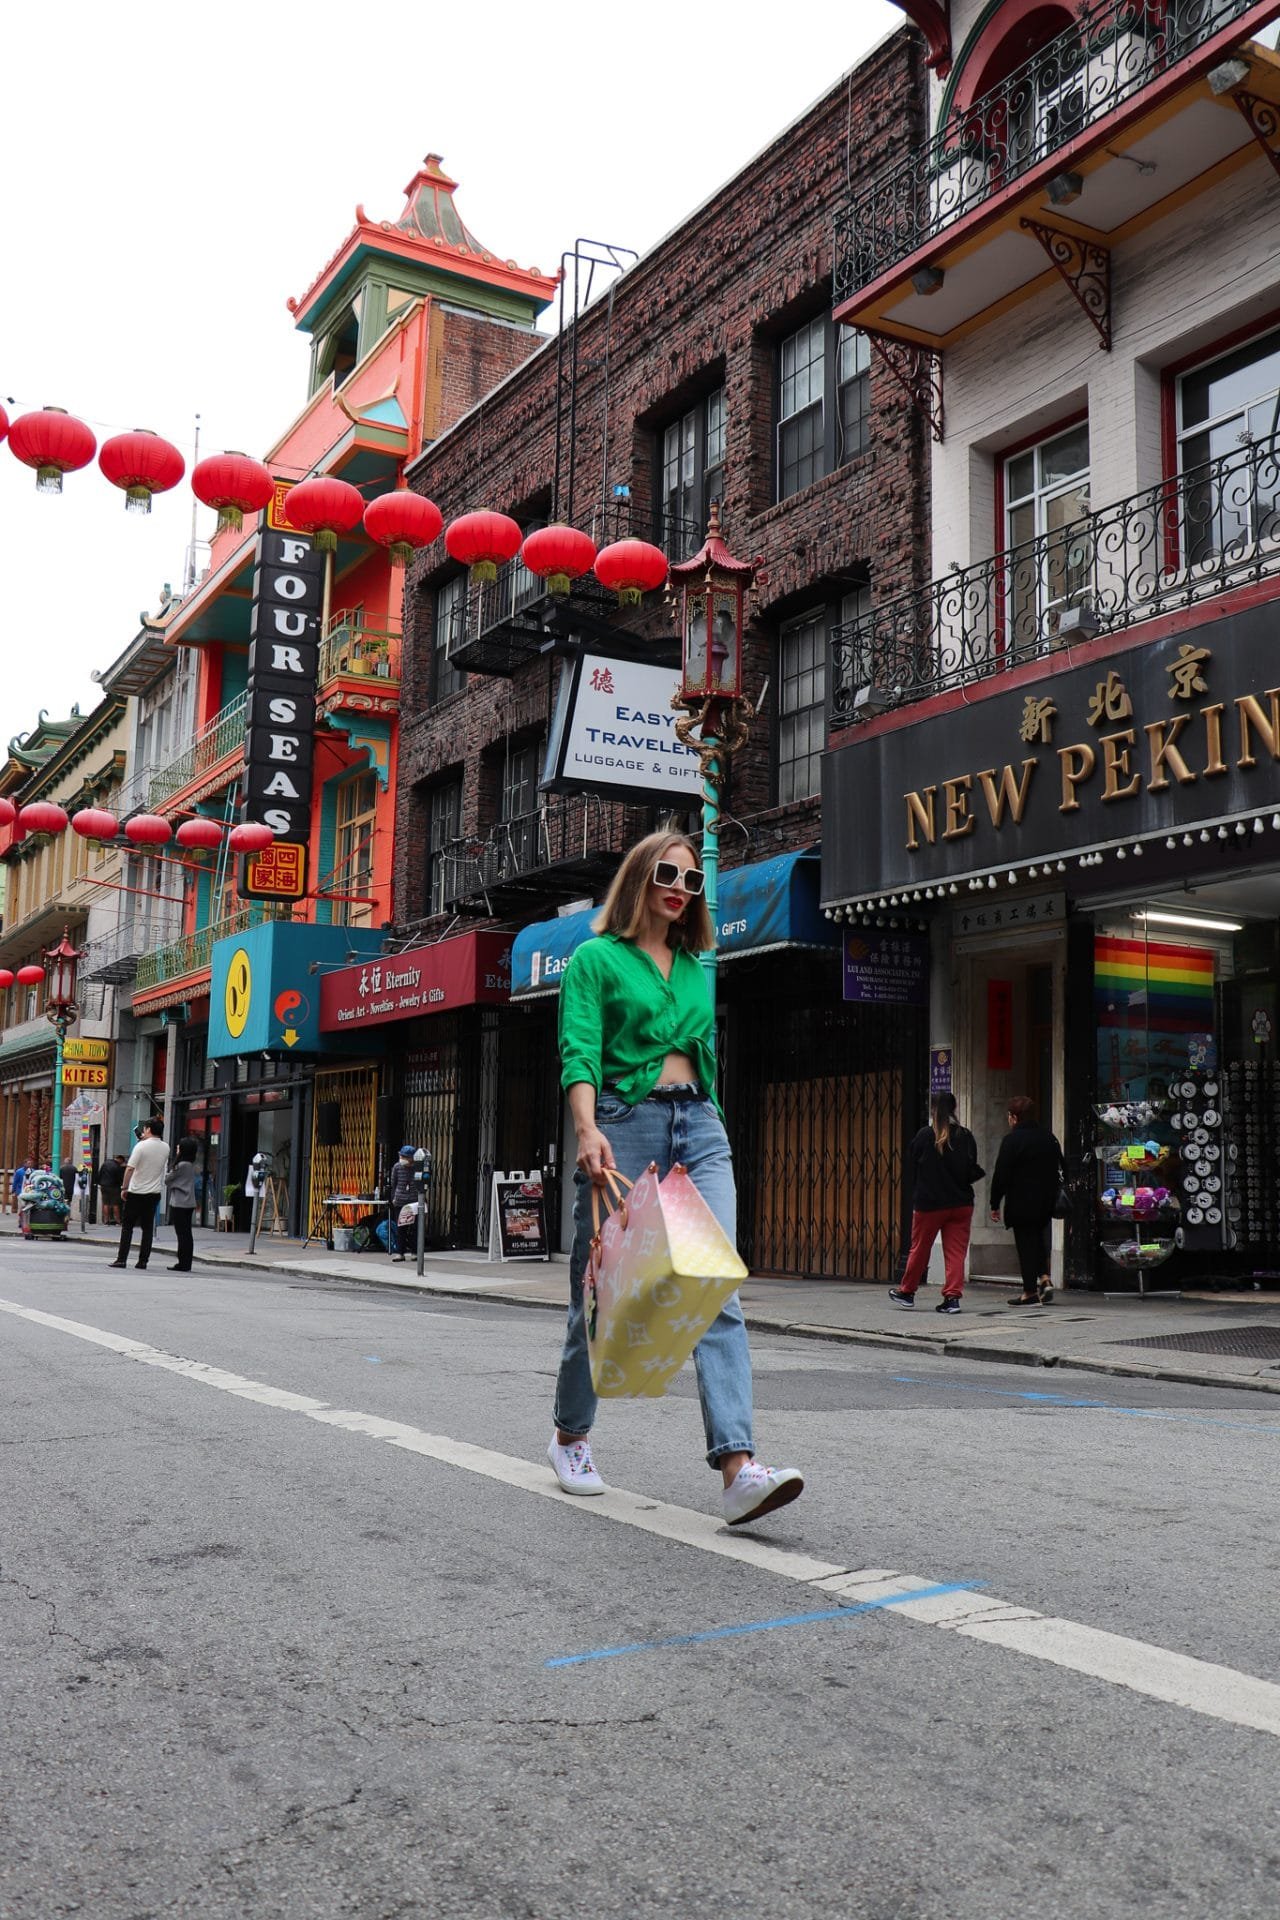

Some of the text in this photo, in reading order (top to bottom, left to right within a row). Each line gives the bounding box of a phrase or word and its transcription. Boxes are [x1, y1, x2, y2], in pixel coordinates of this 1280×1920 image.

[263, 539, 310, 835] FOUR SEAS
[589, 666, 615, 695] 德
[1018, 644, 1212, 744] 新北京
[616, 706, 676, 727] EASY
[575, 753, 705, 780] LUGGAGE & GIFT
[904, 687, 1280, 850] NEW PEKIN
[721, 919, 747, 936] GIFTS
[385, 965, 421, 990] Eternity
[544, 955, 573, 976] Eas
[337, 1008, 355, 1021] Orient
[355, 1006, 366, 1018] Art
[370, 999, 394, 1015] Novelties
[399, 993, 421, 1009] Jewelry
[422, 991, 428, 1004] &
[428, 988, 445, 1003] Gifts
[64, 1042, 107, 1058] CHINA TOWN
[65, 1068, 104, 1083] KITES
